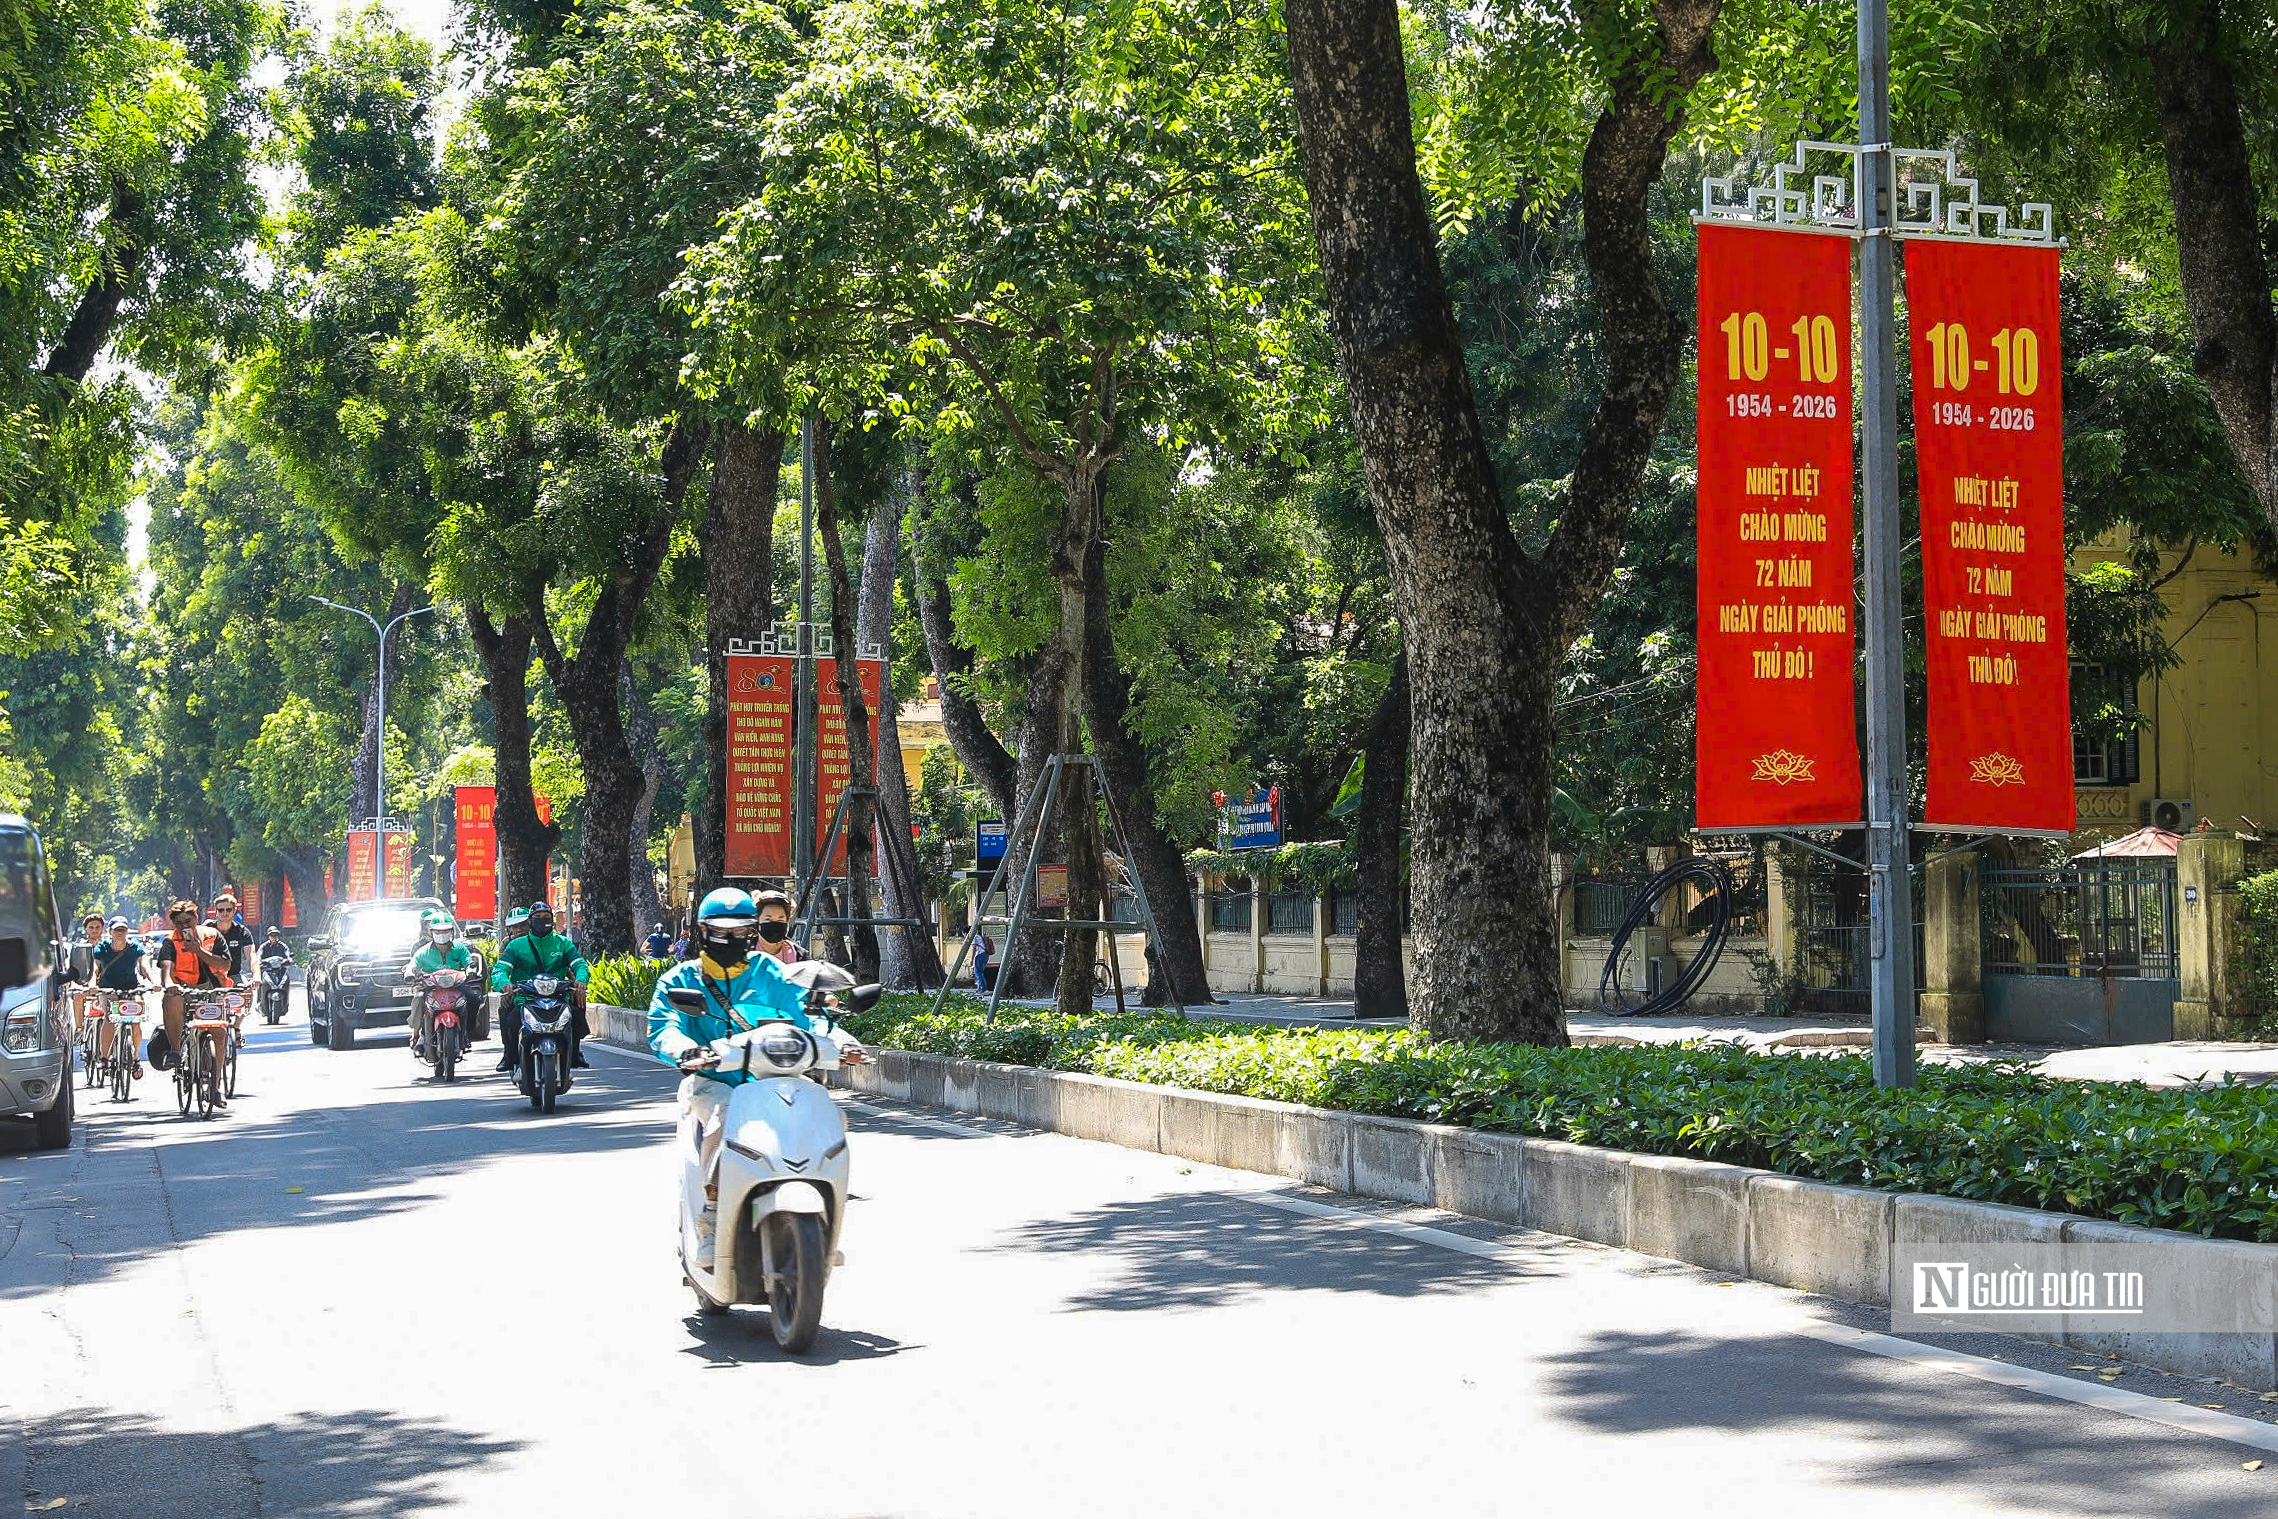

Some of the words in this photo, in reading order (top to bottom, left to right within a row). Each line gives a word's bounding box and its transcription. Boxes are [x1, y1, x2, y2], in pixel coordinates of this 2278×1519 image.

[1720, 311, 1838, 383] 10-10
[1925, 322, 2039, 396] 10-10
[1726, 393, 1772, 418] 1954
[1792, 394, 1837, 419] 2026
[1932, 401, 1972, 427] 1954
[1989, 407, 2035, 431] 2026
[1745, 461, 1788, 502] NHIỆT
[1792, 462, 1820, 503] LIỆT
[1991, 475, 2019, 514] LIỆT
[1740, 507, 1780, 542] CHÀO
[1783, 507, 1827, 542] MỪNG
[1950, 516, 1986, 550] CHÀO
[1986, 519, 2025, 553] MỪNG
[1755, 559, 1774, 587] 72
[1778, 553, 1812, 587] NĂM
[1966, 567, 1982, 594] 72
[1985, 564, 2012, 597] NĂM
[1720, 598, 1759, 633] NGÀY
[1762, 595, 1793, 633] GIẢI
[1797, 599, 1846, 633] PHÓNG
[1940, 604, 1972, 638] NGÀY
[1975, 603, 2001, 640] GIẢI
[2002, 609, 2046, 643] PHÓNG
[1752, 641, 1781, 679] THỦ
[1967, 647, 1993, 684] THỦ
[2186, 890, 2196, 899] 30
